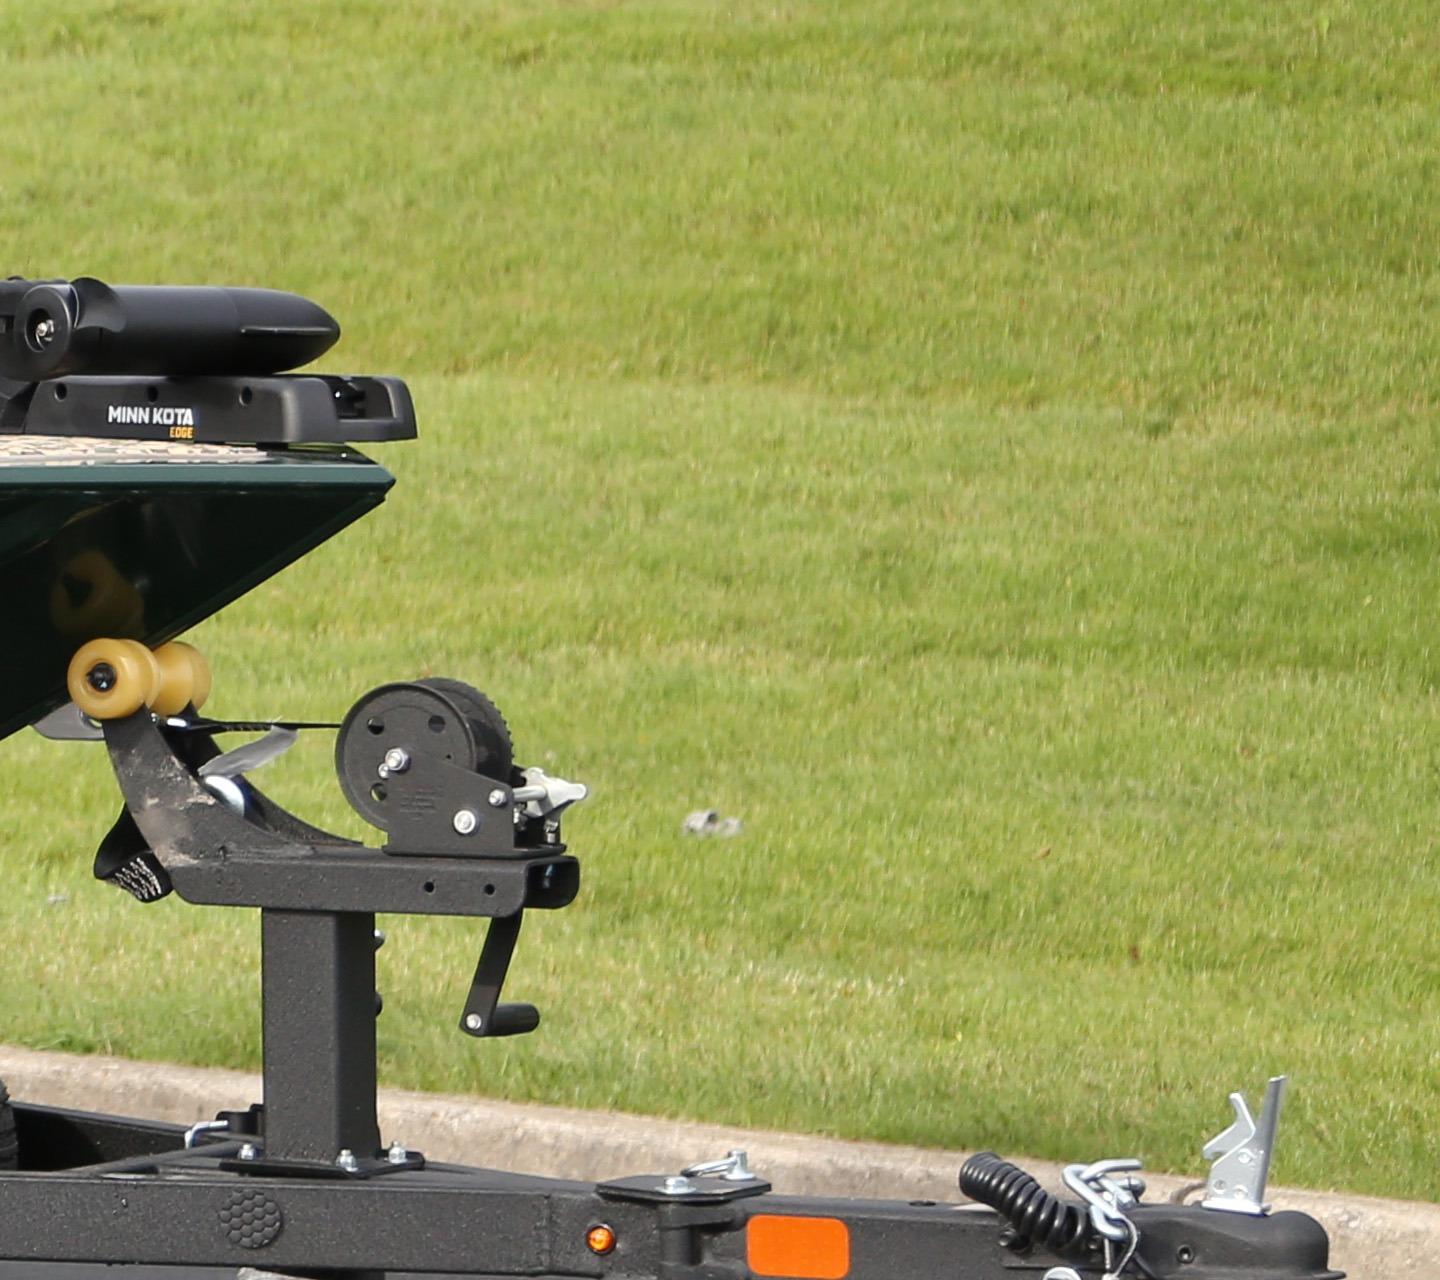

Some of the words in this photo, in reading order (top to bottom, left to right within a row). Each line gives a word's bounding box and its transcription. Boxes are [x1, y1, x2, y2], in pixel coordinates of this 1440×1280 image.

[107, 405, 150, 424] MINN
[152, 407, 194, 426] KOTA
[169, 426, 194, 439] EDGE
